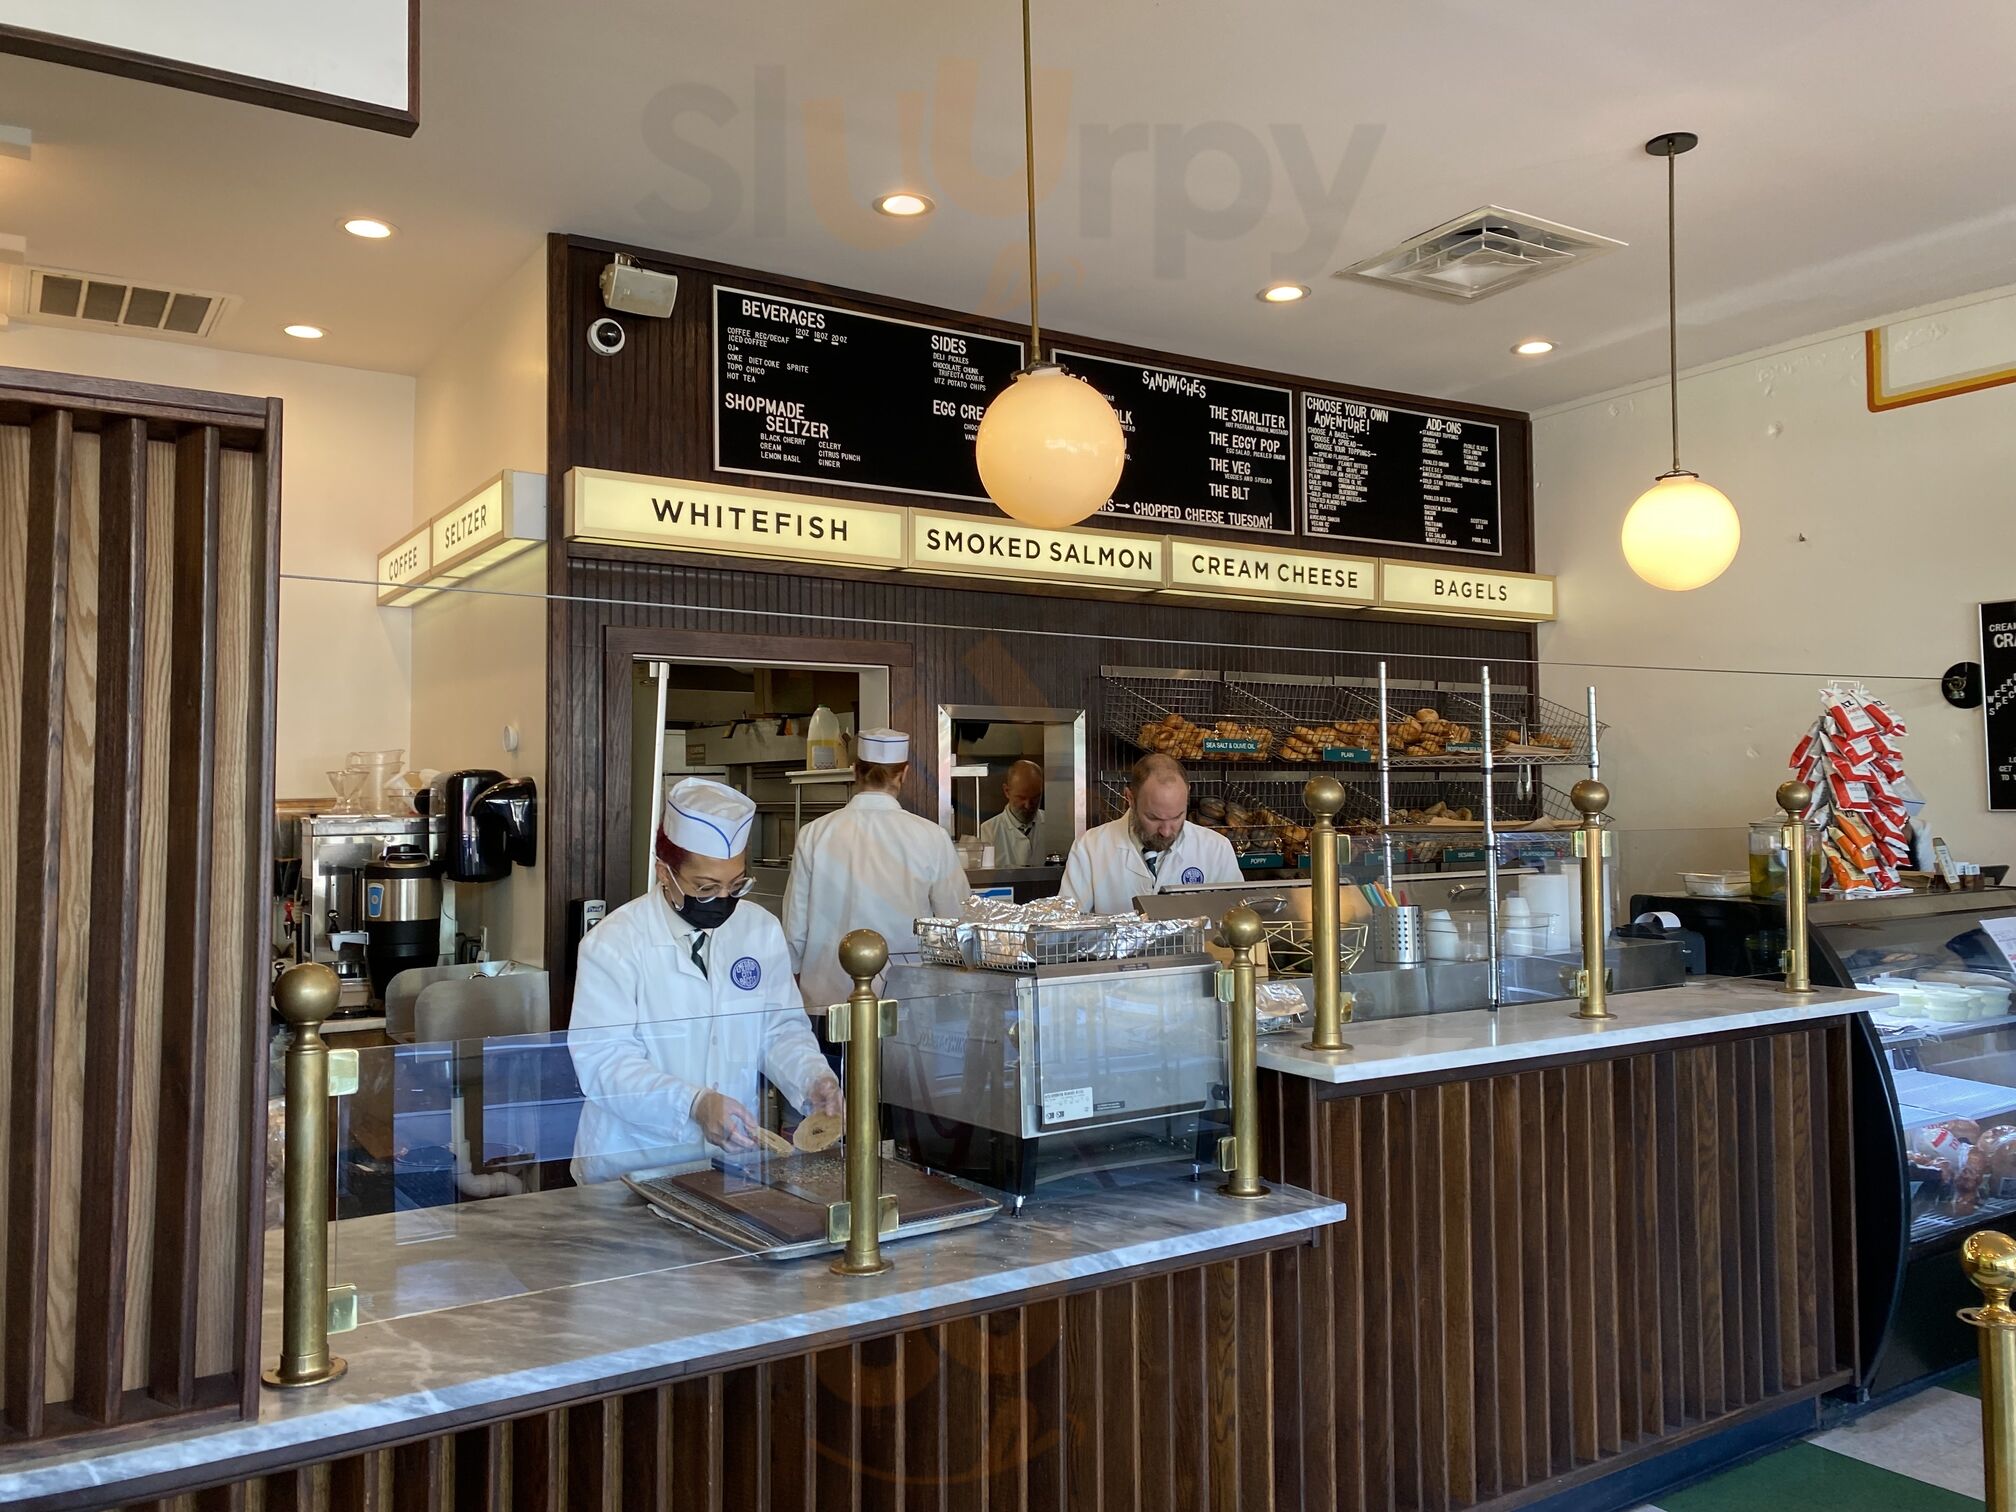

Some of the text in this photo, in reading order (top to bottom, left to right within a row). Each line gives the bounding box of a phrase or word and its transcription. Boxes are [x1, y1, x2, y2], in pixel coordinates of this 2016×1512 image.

[742, 299, 825, 329] BEVERAGES
[727, 327, 790, 344] COFFEE REG/DECAF
[728, 335, 768, 348] ICED COFFEE
[931, 335, 967, 355] SIDES
[727, 353, 809, 373] COKE DIET COKE SPRITE
[933, 352, 969, 364] DELI PICKLES
[727, 362, 765, 375] TOPO CHICO
[932, 361, 979, 374] CHOCOLATE CHUNK
[939, 369, 984, 382] TRIFECTA COOKIE
[726, 372, 756, 383] HOT TEA
[934, 377, 986, 391] UTZ POTATO CHIPS
[1142, 370, 1206, 399] SANDWICHES
[725, 392, 805, 420] SHOPMADE
[933, 400, 984, 421] EGG CRE
[1307, 397, 1388, 423] CHOOSE YOUR OWN
[1209, 405, 1285, 429] THE STARLITER
[1314, 411, 1369, 435] ADVENTURE!
[766, 415, 829, 439] SELTZER
[964, 423, 980, 431] CHOC
[1308, 427, 1326, 436] CHOOSE
[1426, 418, 1462, 435] ADD-ONS
[760, 433, 806, 445] BLACK CHERRY
[818, 441, 841, 450] CELERY
[964, 433, 977, 441] VAN
[1209, 431, 1280, 453] THE EGGY POP
[1311, 435, 1330, 443] CHOOSE
[1338, 439, 1356, 448] SPREAD
[760, 442, 782, 451] CREAM
[1314, 442, 1333, 451] CHOOSE
[1334, 445, 1345, 453] YOUR
[760, 451, 801, 463] LEMON BASIL
[818, 450, 861, 462] CITRUS PUNCH
[818, 459, 841, 468] GINGER
[1209, 458, 1251, 475] THE VEG
[1208, 483, 1250, 500] THE BLT
[651, 497, 848, 541] WHITEFISH
[1133, 502, 1181, 519] CHOPPED
[1185, 508, 1225, 524] CHEESE
[1228, 512, 1272, 529] TUESDAY!
[445, 504, 487, 549] SELTZER
[927, 528, 1152, 571] SMOKED SALMON
[389, 547, 417, 581] COFFEE
[1192, 555, 1358, 589] CREAM CHEESE
[1434, 579, 1508, 601] BAGELS
